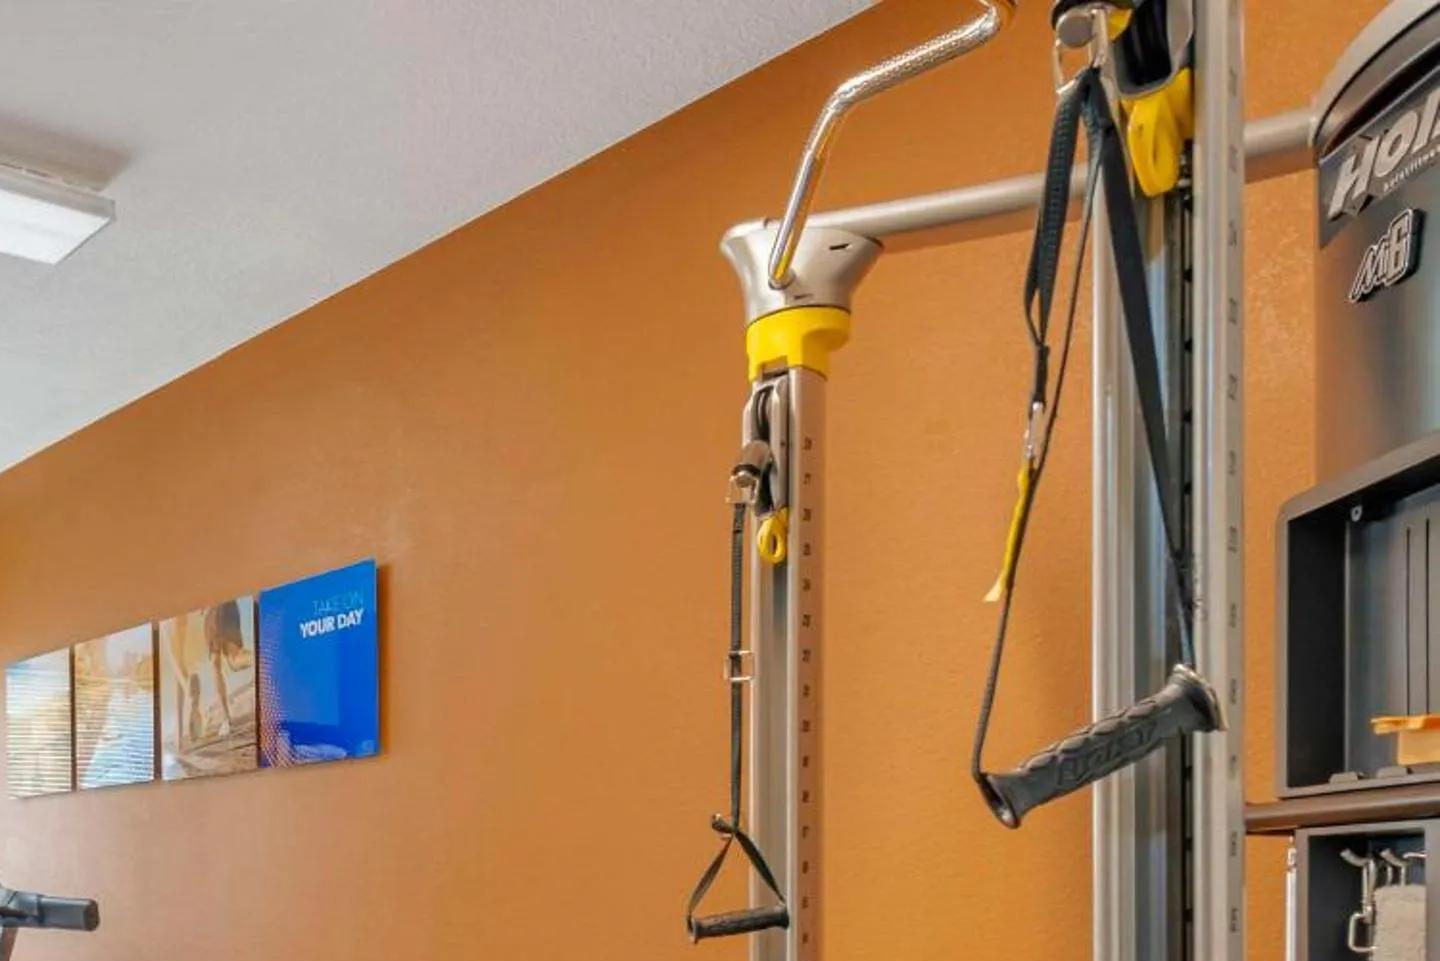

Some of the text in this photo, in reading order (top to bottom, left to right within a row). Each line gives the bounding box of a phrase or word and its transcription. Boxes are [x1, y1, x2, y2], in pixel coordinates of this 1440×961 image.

[1327, 87, 1440, 218] HOI
[299, 608, 364, 639] YOUR DAY
